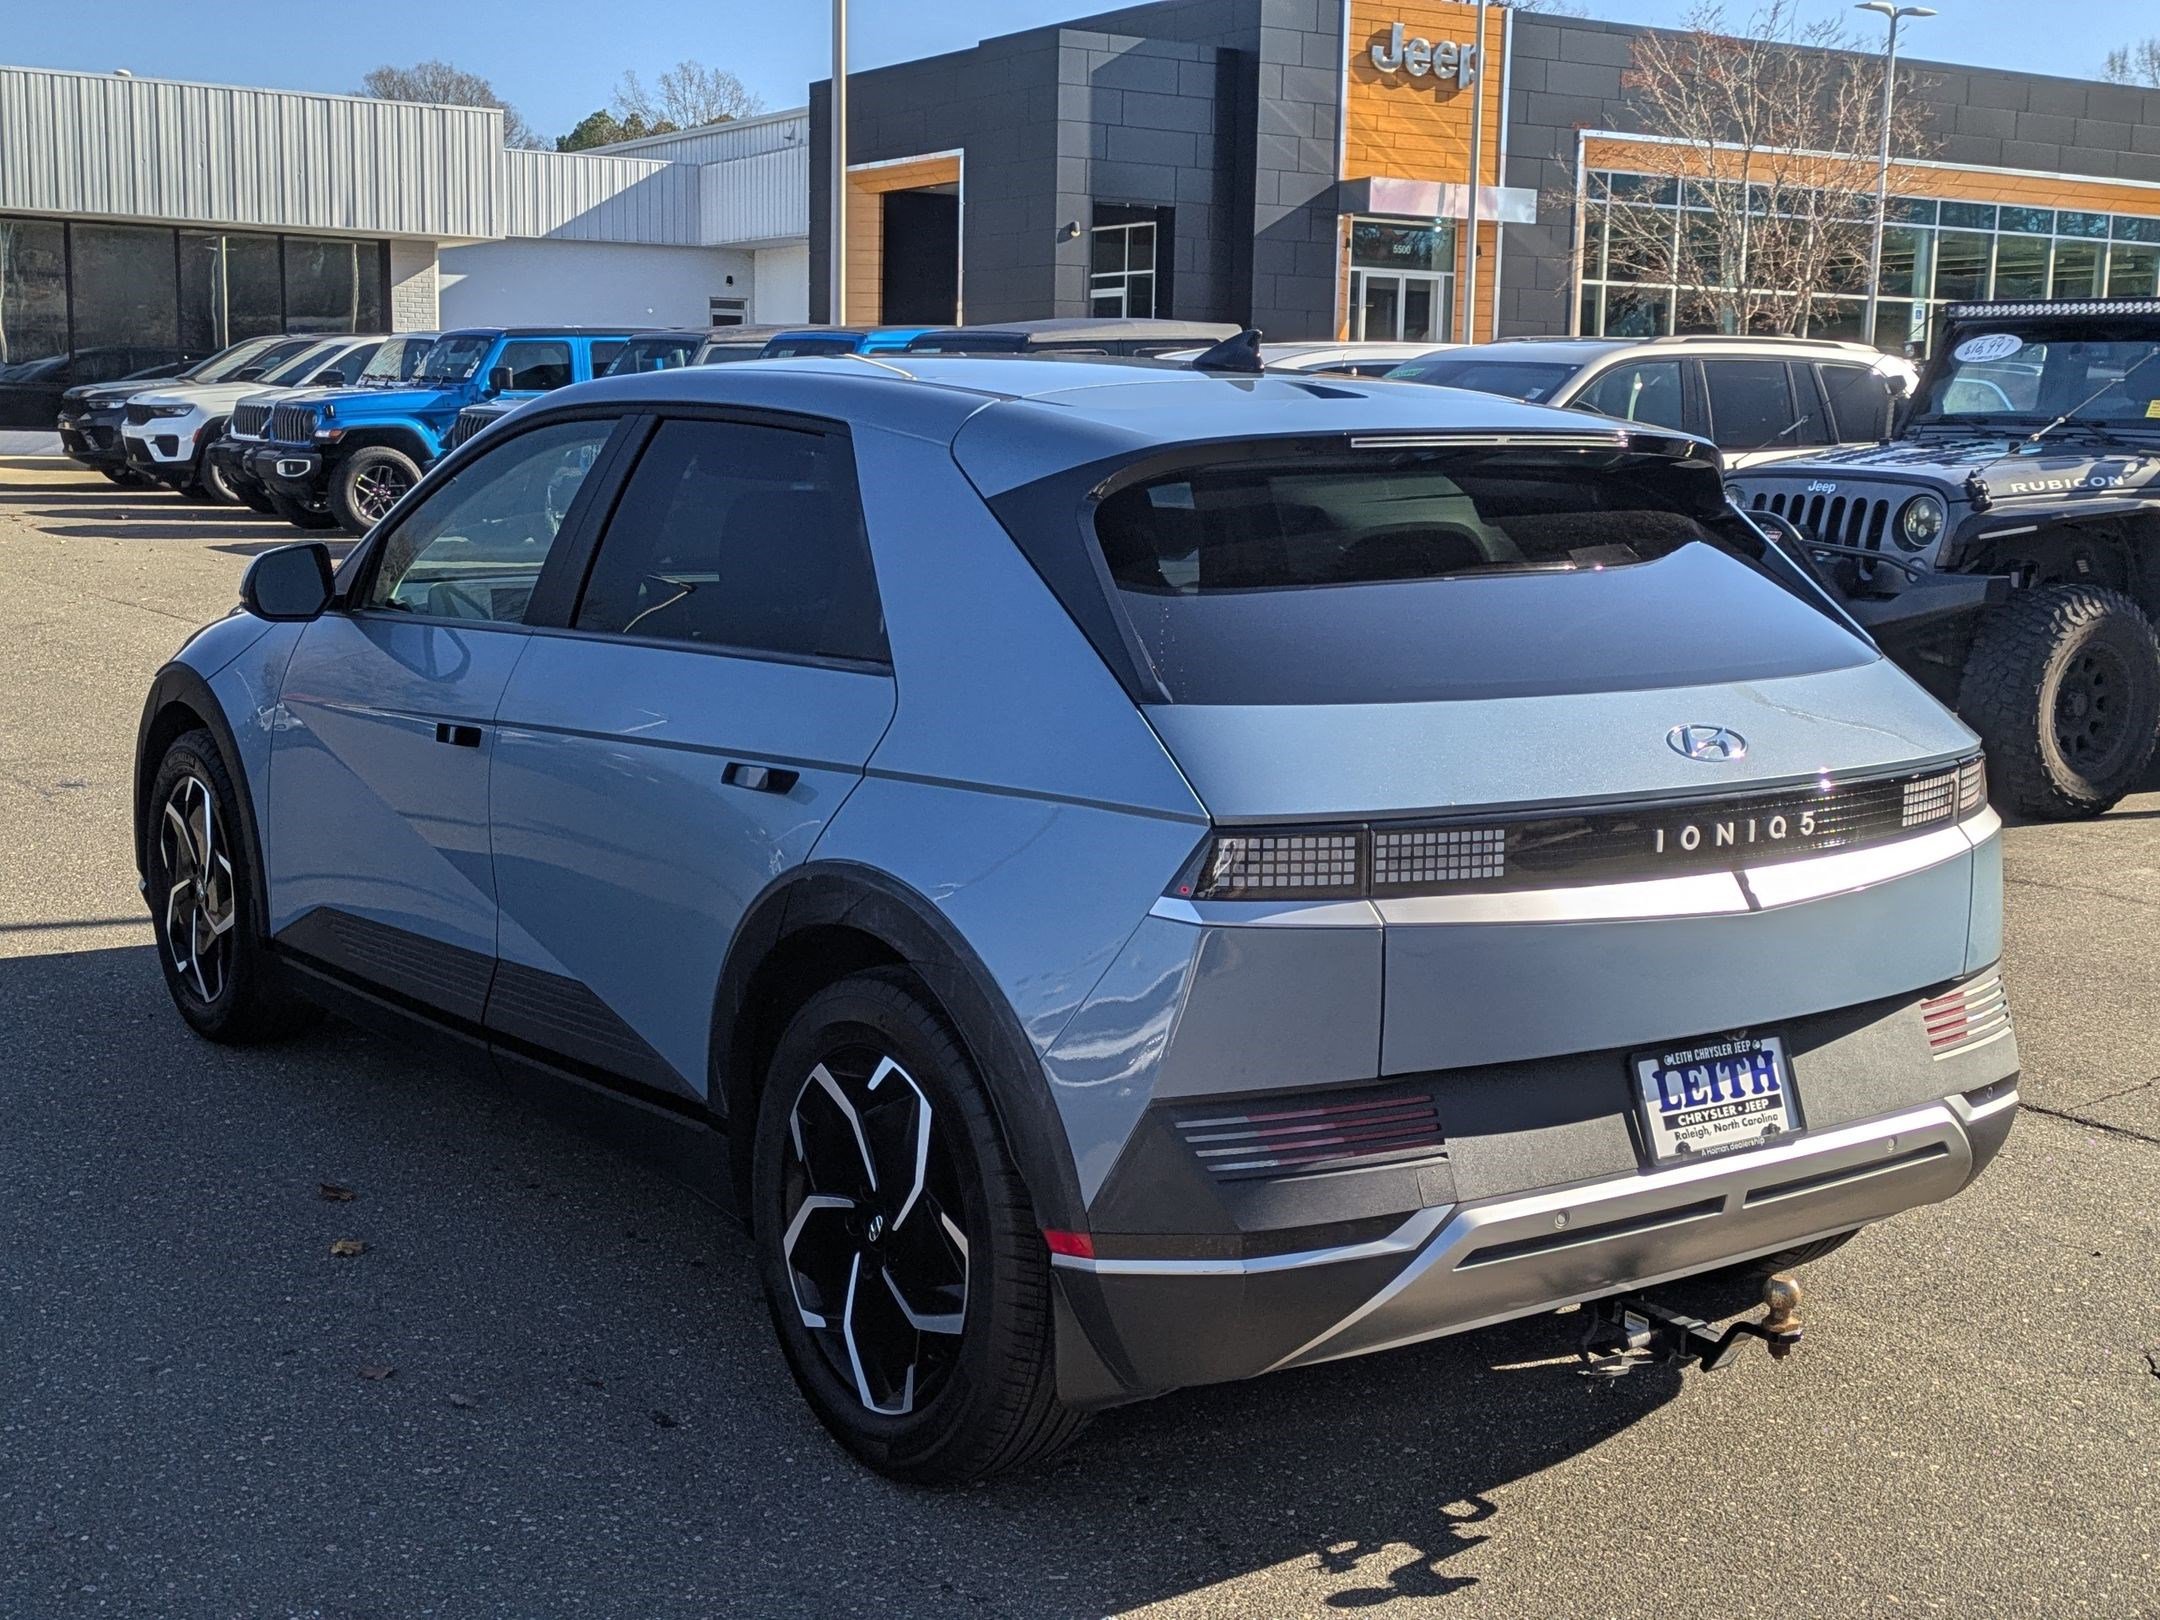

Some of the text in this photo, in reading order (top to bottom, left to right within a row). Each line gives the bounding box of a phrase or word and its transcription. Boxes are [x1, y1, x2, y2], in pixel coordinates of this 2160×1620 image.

[1808, 480, 1837, 494] Jeep
[2010, 475, 2124, 493] RUBICON
[1671, 1040, 1751, 1065] LEITH CHRYSLER JEEP
[1652, 1050, 1780, 1113] LEITH
[1678, 1098, 1769, 1126] CHRYSLER JEEP
[1674, 1112, 1779, 1141] Raleigh, North Carolina
[1730, 1137, 1766, 1151] dealership
